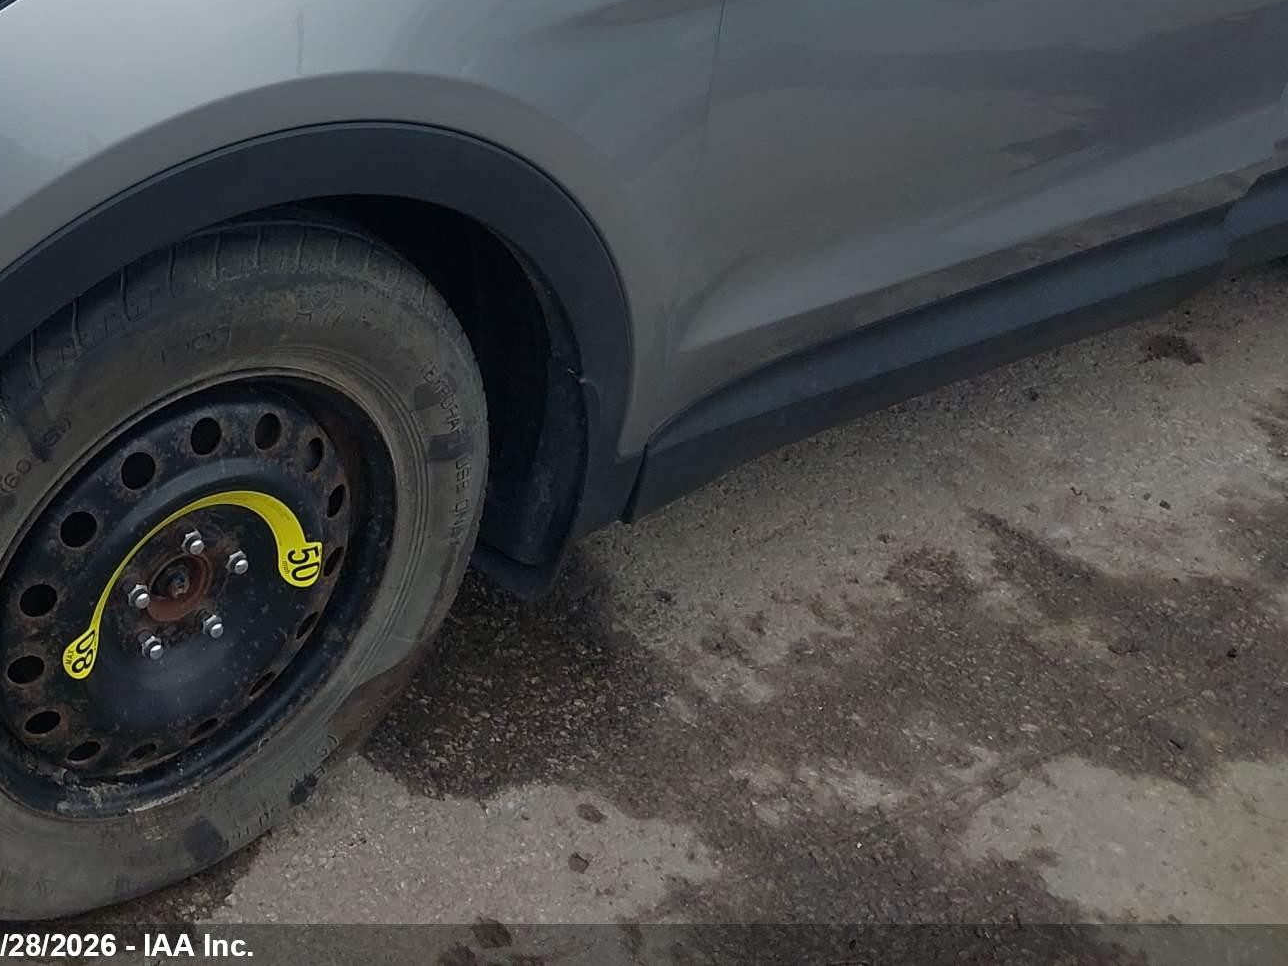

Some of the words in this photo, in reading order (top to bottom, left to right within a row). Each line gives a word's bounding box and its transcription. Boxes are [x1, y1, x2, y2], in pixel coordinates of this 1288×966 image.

[287, 545, 320, 582] 50
[64, 649, 75, 665] MAX
[71, 629, 96, 674] 80
